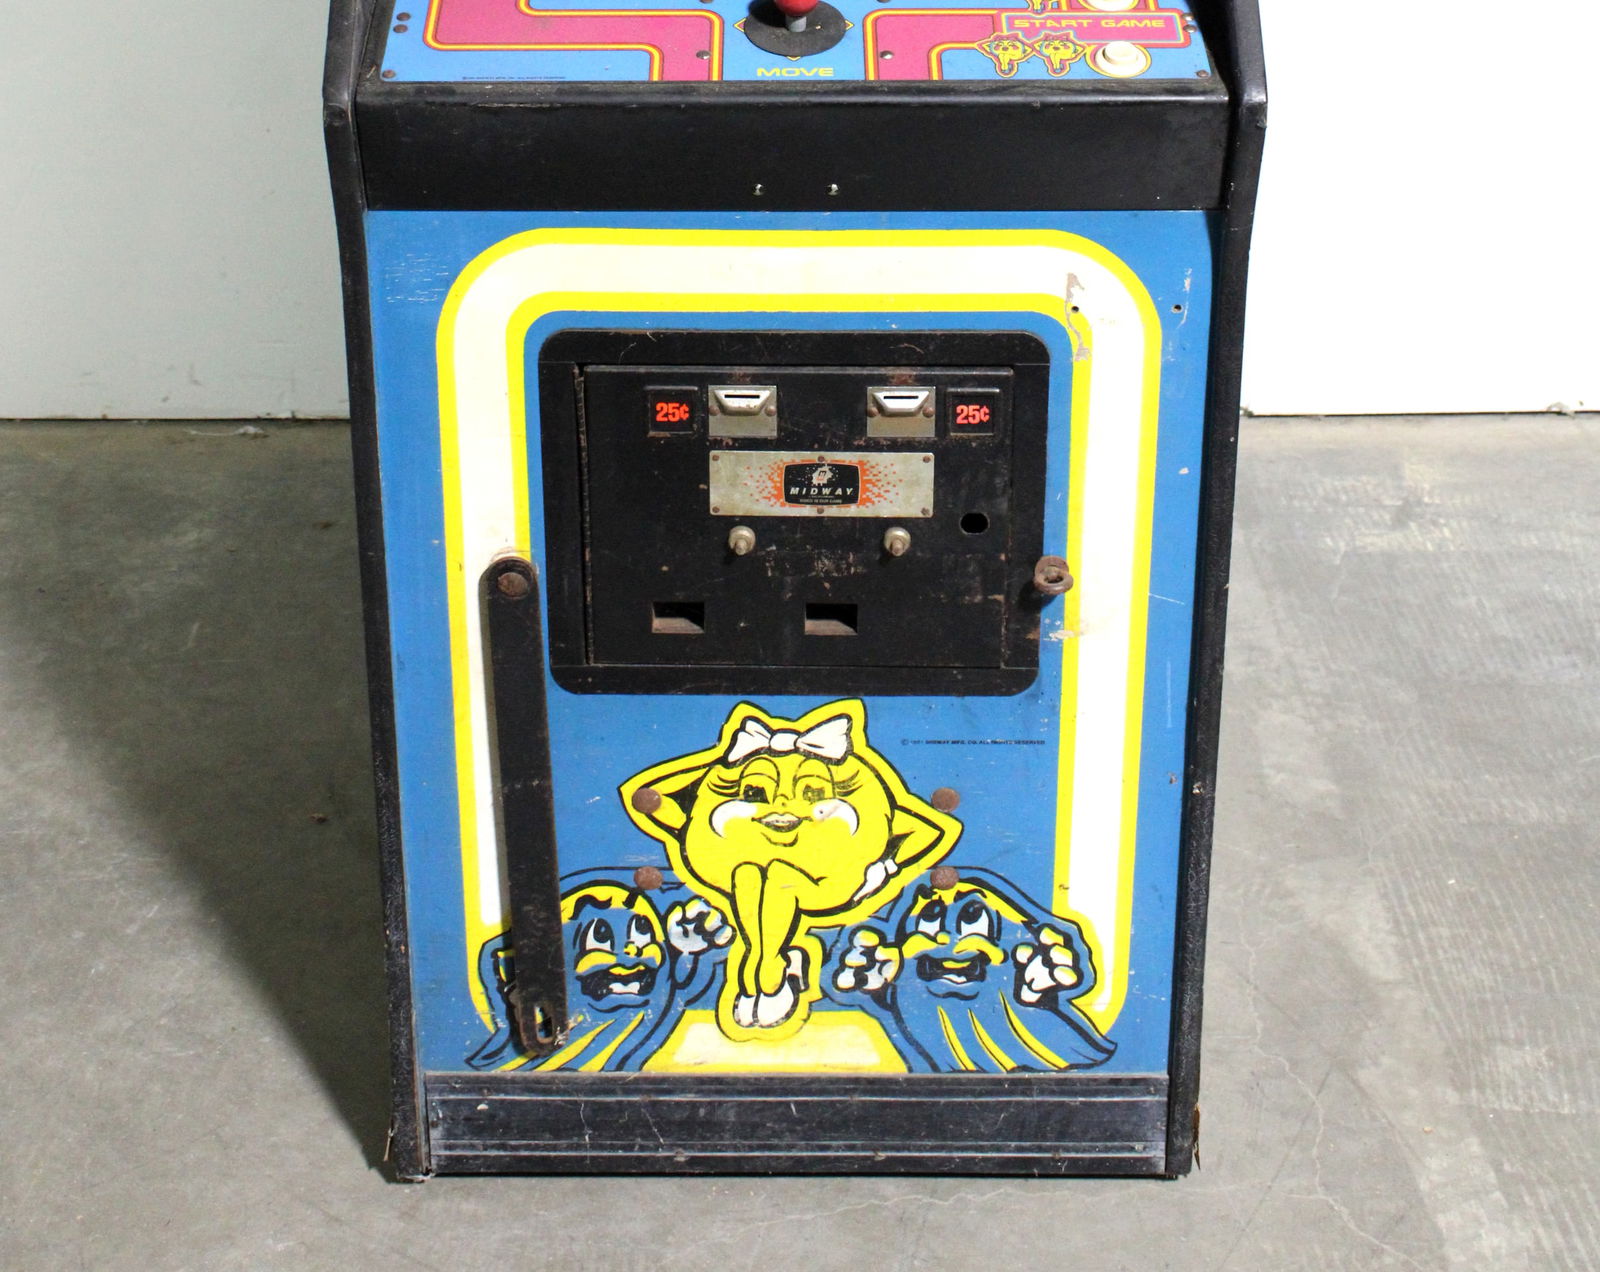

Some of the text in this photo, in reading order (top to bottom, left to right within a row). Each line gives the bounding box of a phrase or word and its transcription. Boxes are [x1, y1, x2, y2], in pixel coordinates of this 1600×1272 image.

[1013, 19, 1166, 28] START GAME
[756, 67, 835, 77] MOVE
[655, 402, 690, 423] 25¢
[955, 404, 991, 425] 25¢
[789, 487, 855, 496] MIDWAY
